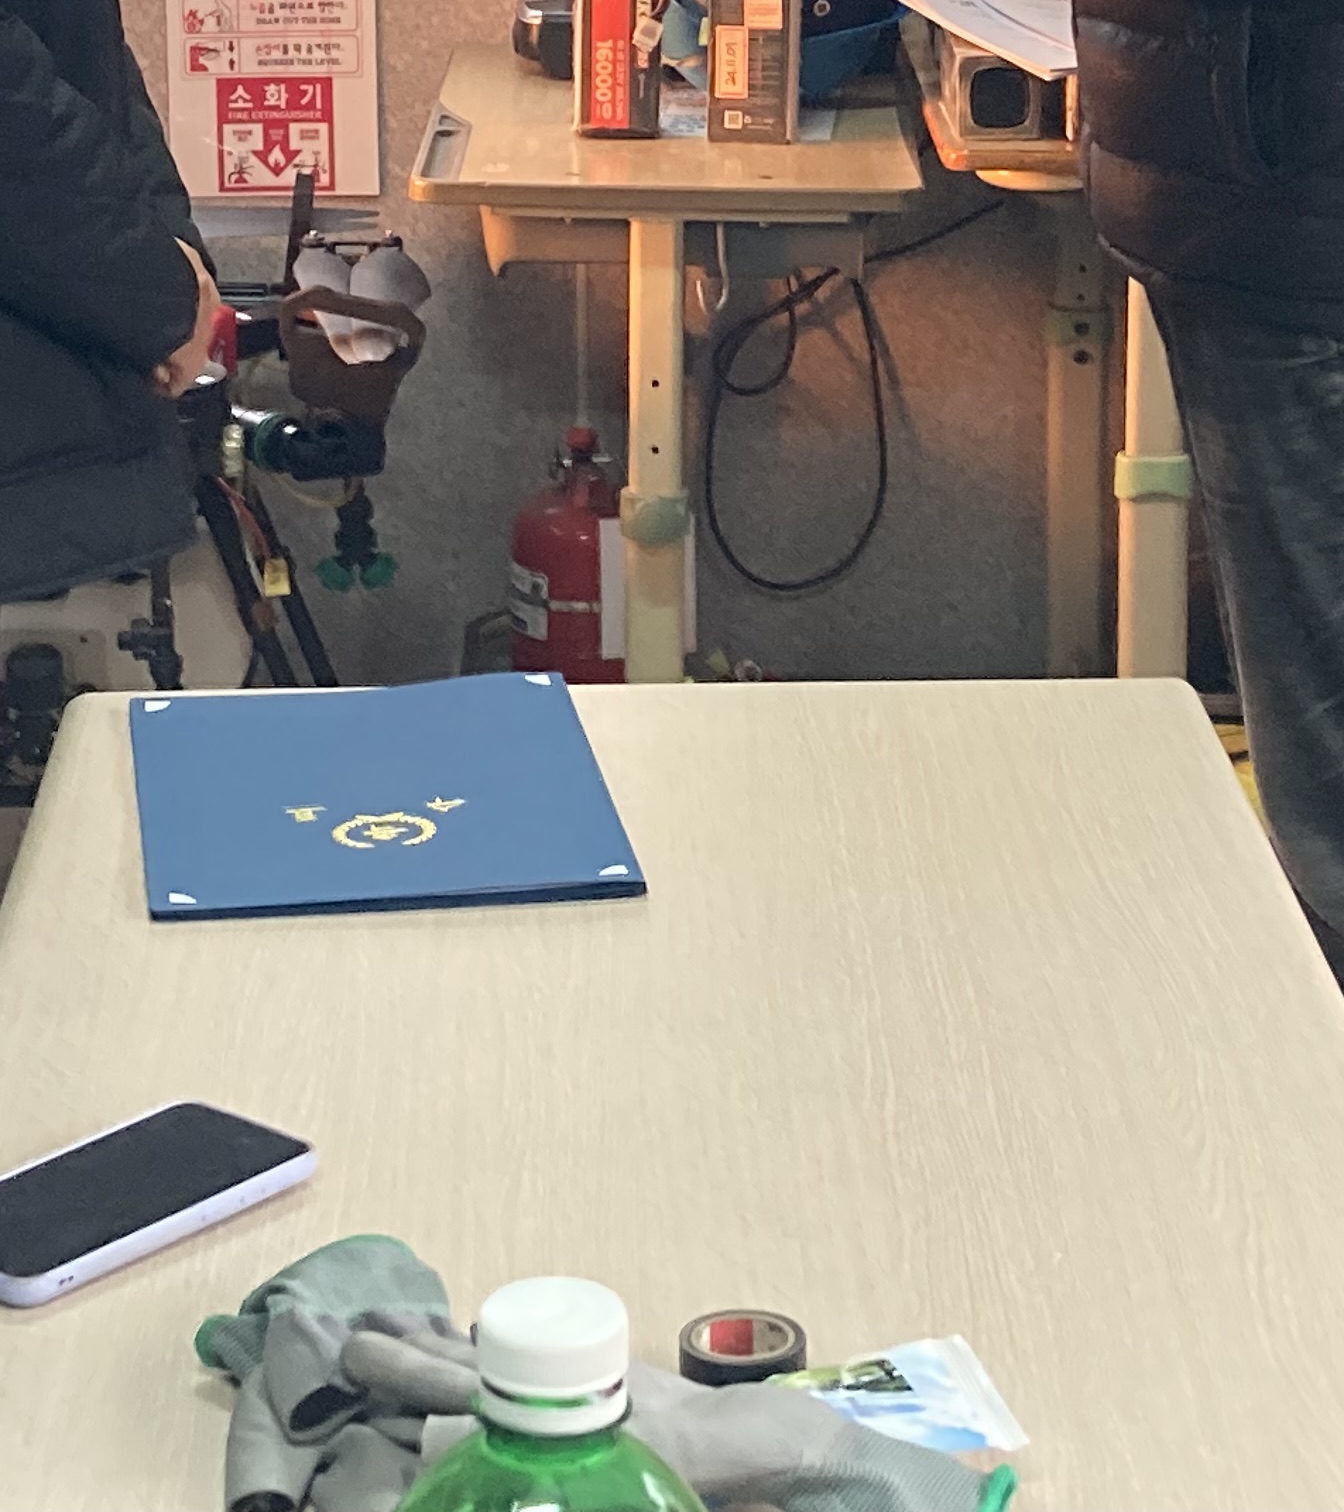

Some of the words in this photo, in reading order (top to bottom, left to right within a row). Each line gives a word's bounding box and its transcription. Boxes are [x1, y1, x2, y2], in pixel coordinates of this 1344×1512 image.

[595, 38, 613, 101] 16000
[228, 111, 249, 120] FIRE
[251, 110, 323, 120] EXTINGUISHER
